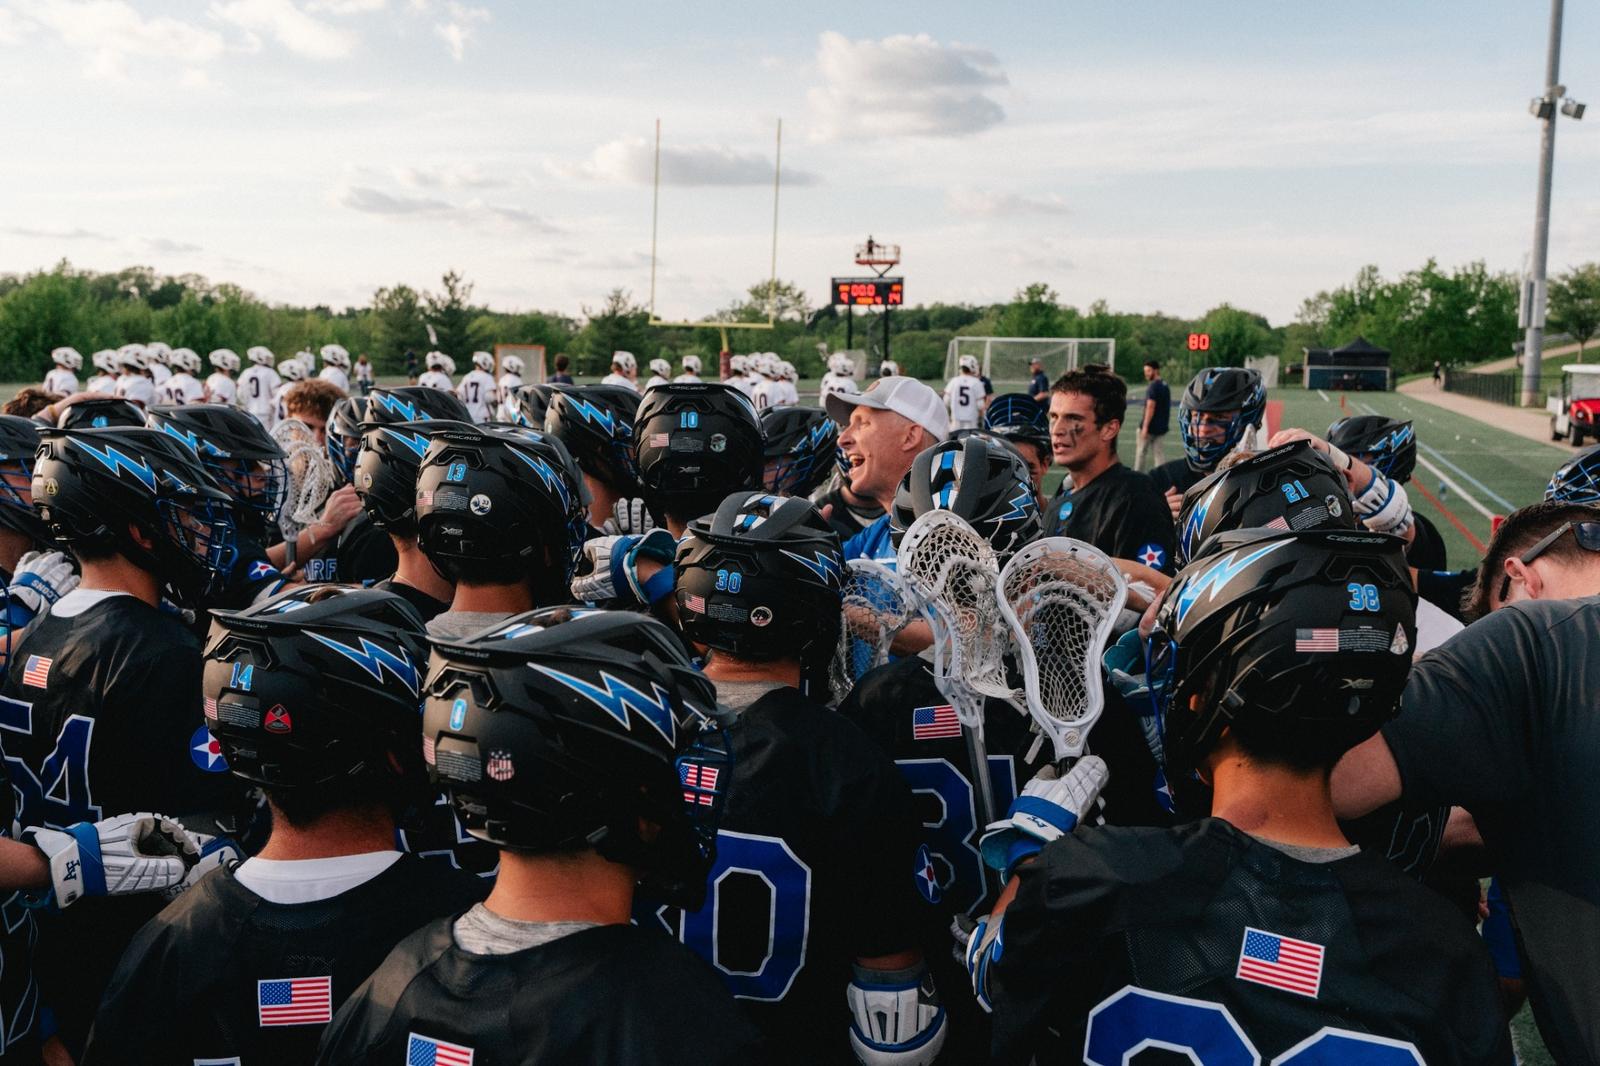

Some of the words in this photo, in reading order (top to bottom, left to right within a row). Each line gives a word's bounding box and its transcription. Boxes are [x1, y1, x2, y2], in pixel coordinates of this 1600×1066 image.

[1188, 334, 1210, 350] 80
[464, 382, 480, 403] 17
[959, 386, 970, 407] 5
[680, 411, 699, 429] 10
[446, 463, 467, 482] 13
[1281, 479, 1310, 504] 21
[715, 569, 742, 594] 30
[1347, 582, 1381, 612] 38
[230, 661, 255, 692] 14
